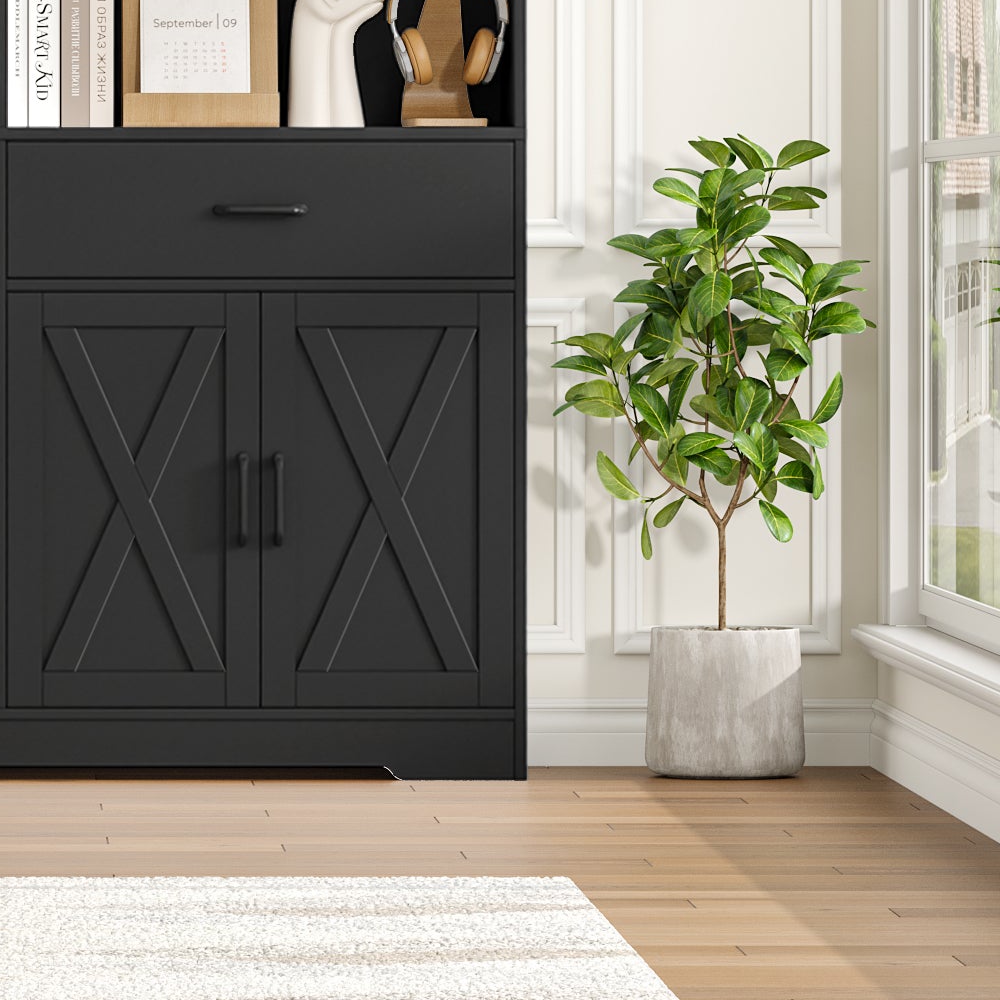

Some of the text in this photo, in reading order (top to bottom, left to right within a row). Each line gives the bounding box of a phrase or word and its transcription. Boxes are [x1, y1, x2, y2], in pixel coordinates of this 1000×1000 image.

[97, 6, 107, 48] ОБРАЗ
[153, 18, 237, 30] September 09
[97, 52, 107, 102] ЖИЗНИ
